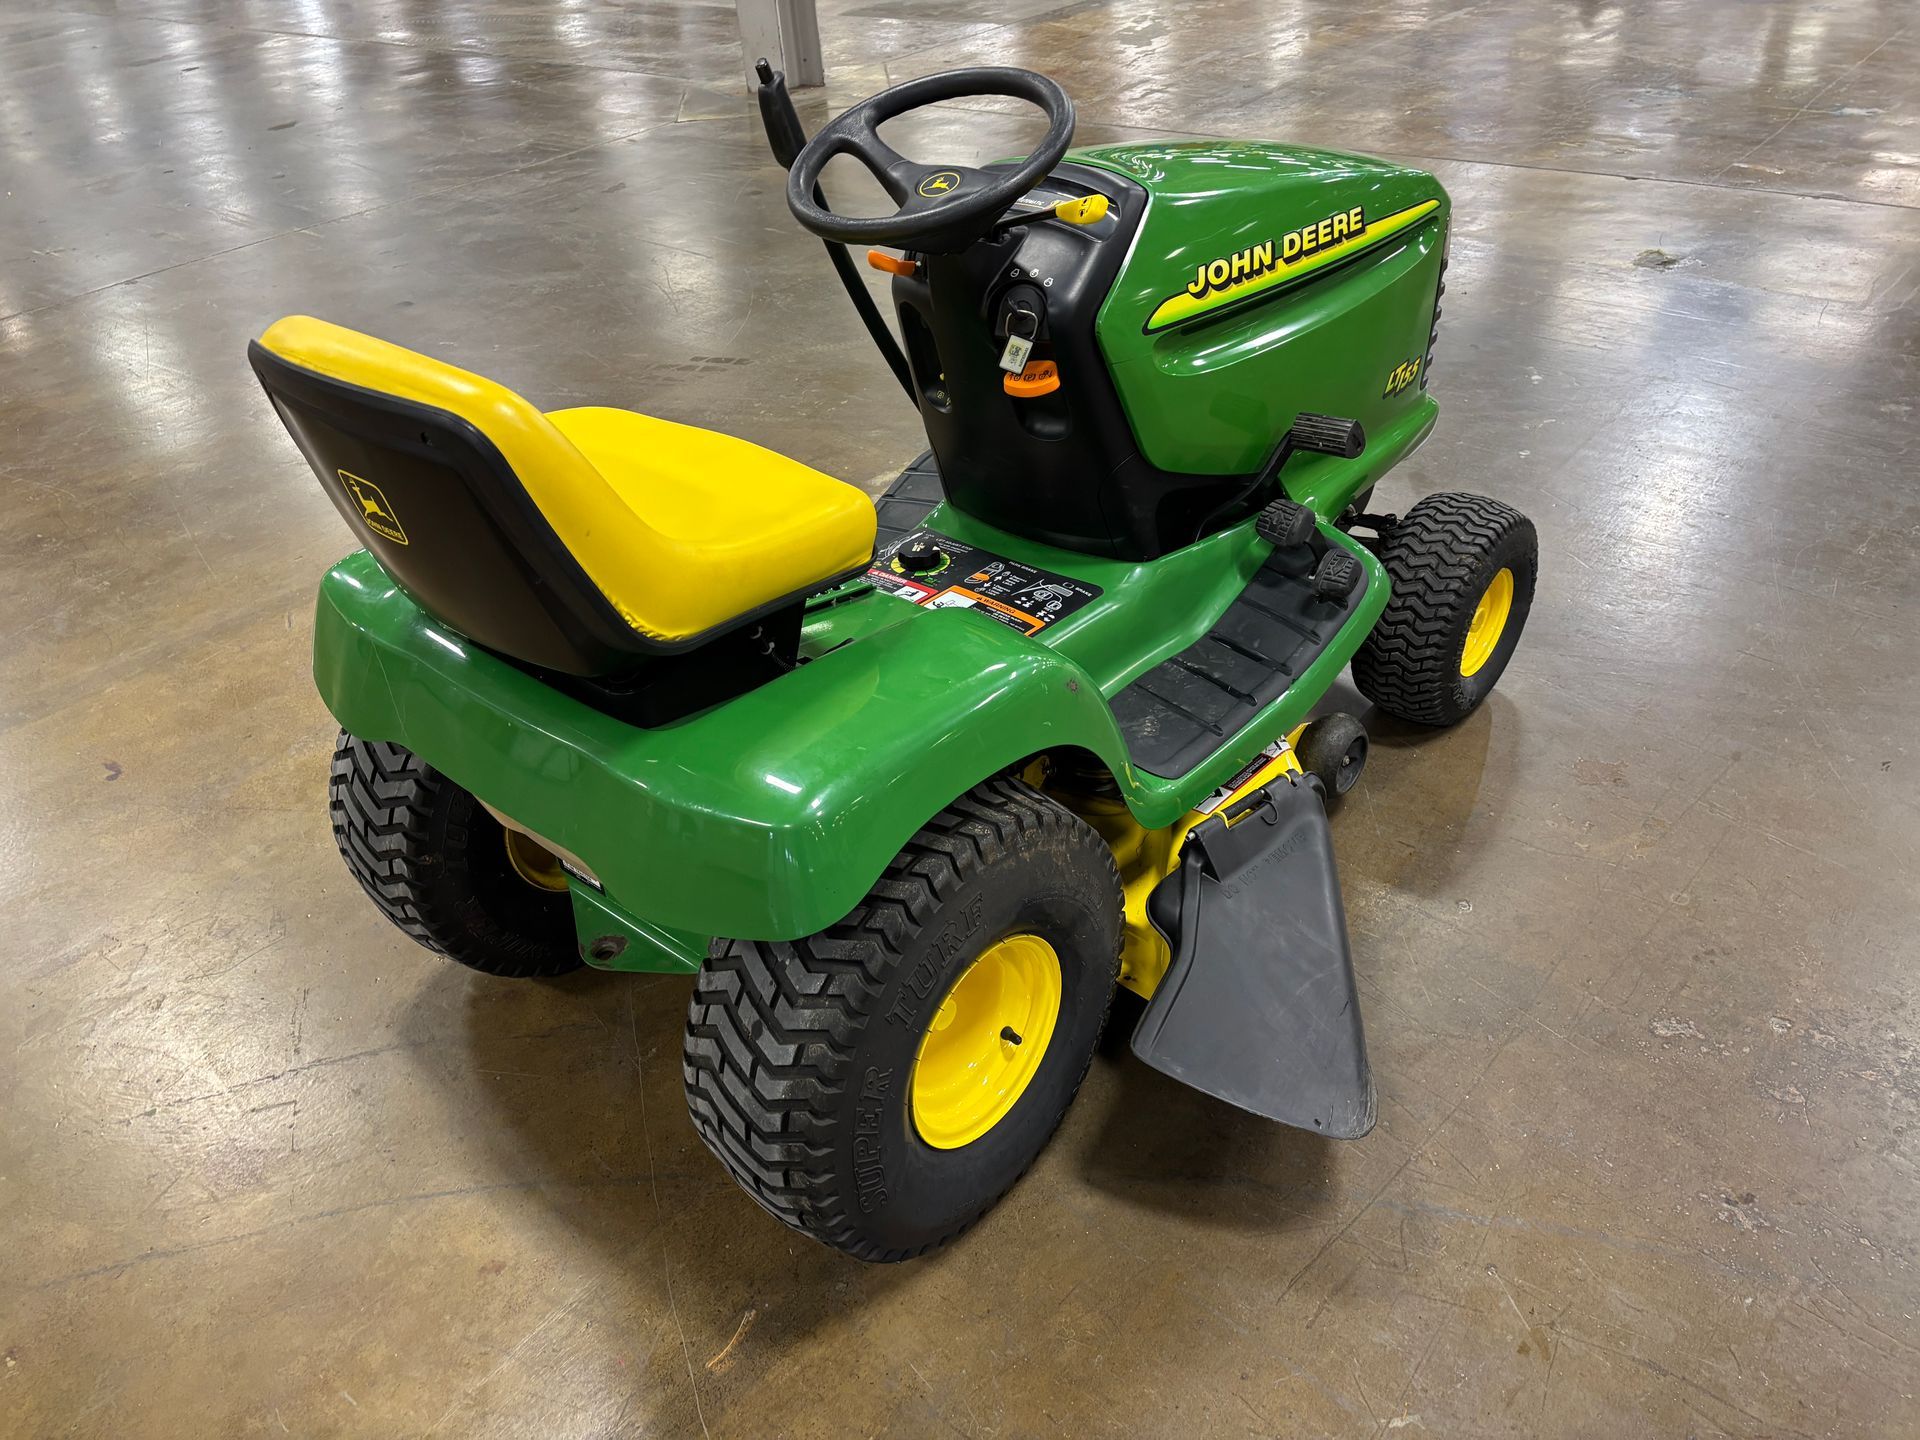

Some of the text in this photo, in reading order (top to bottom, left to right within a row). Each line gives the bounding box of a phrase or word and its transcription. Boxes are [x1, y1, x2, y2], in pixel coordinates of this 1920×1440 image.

[1187, 205, 1366, 299] JOHN DEERE
[1383, 356, 1422, 399] LT155
[878, 571, 908, 585] DANGER
[1074, 586, 1093, 597] BRAKE
[983, 598, 1016, 614] WARNING
[853, 891, 987, 1214] SUPER TURF
